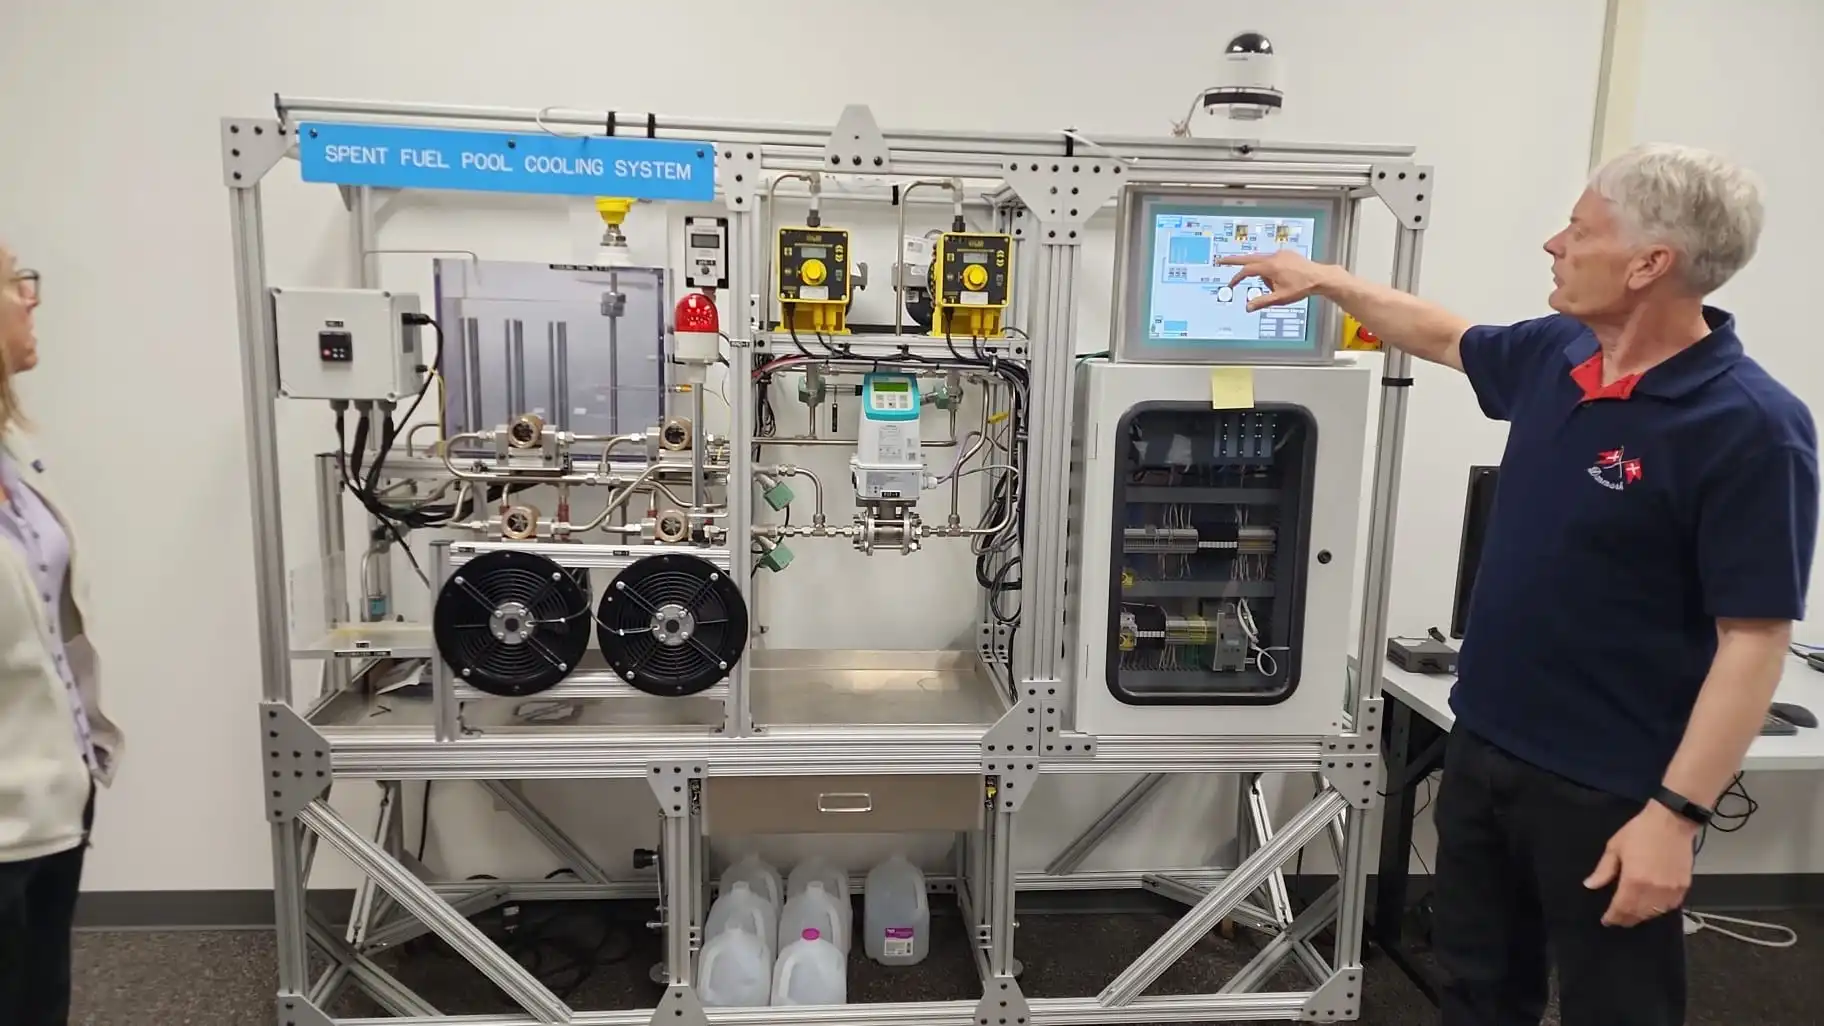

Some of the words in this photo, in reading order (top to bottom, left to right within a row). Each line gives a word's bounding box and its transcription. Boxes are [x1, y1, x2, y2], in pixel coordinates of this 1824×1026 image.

[324, 144, 388, 166] SPENT
[400, 148, 449, 169] FUEL
[461, 152, 513, 172] POOL
[524, 155, 604, 176] COOLING
[615, 159, 692, 181] SYSTEM
